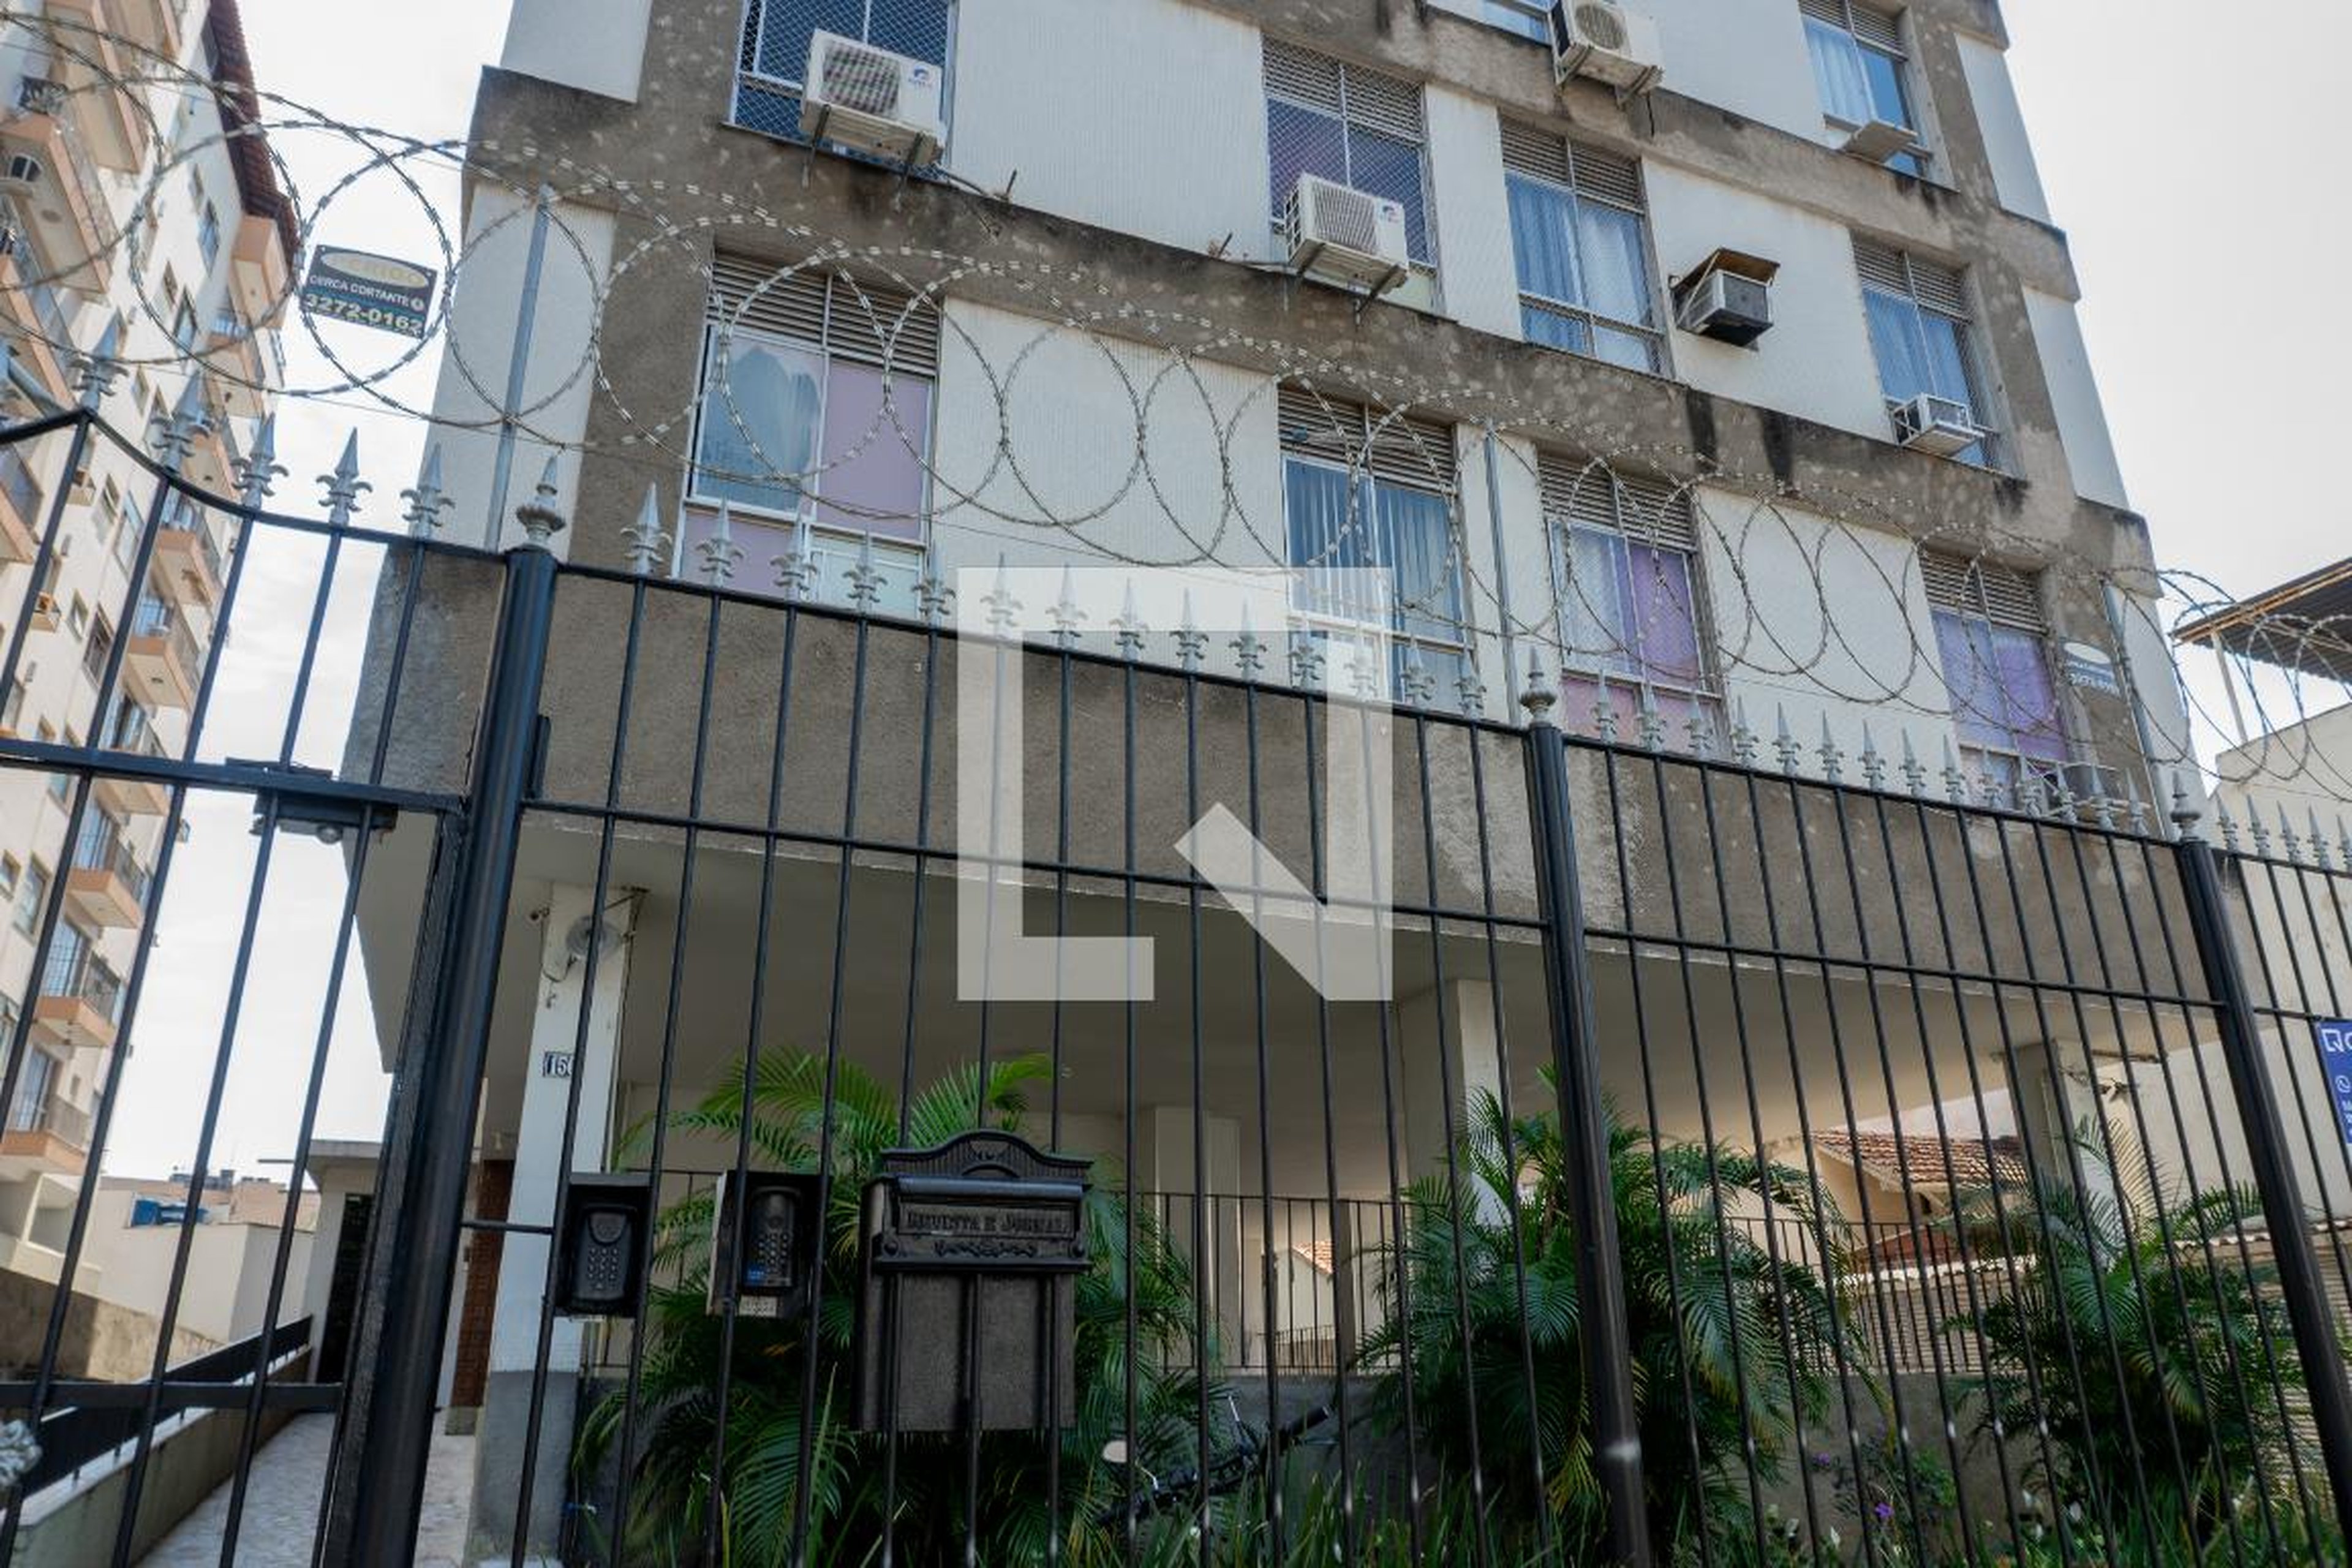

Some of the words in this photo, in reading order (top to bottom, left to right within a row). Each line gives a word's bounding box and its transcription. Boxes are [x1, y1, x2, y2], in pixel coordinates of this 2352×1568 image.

[309, 274, 348, 292] CERCA
[350, 283, 409, 307] CORTANTE
[304, 293, 423, 334] 3272-0162
